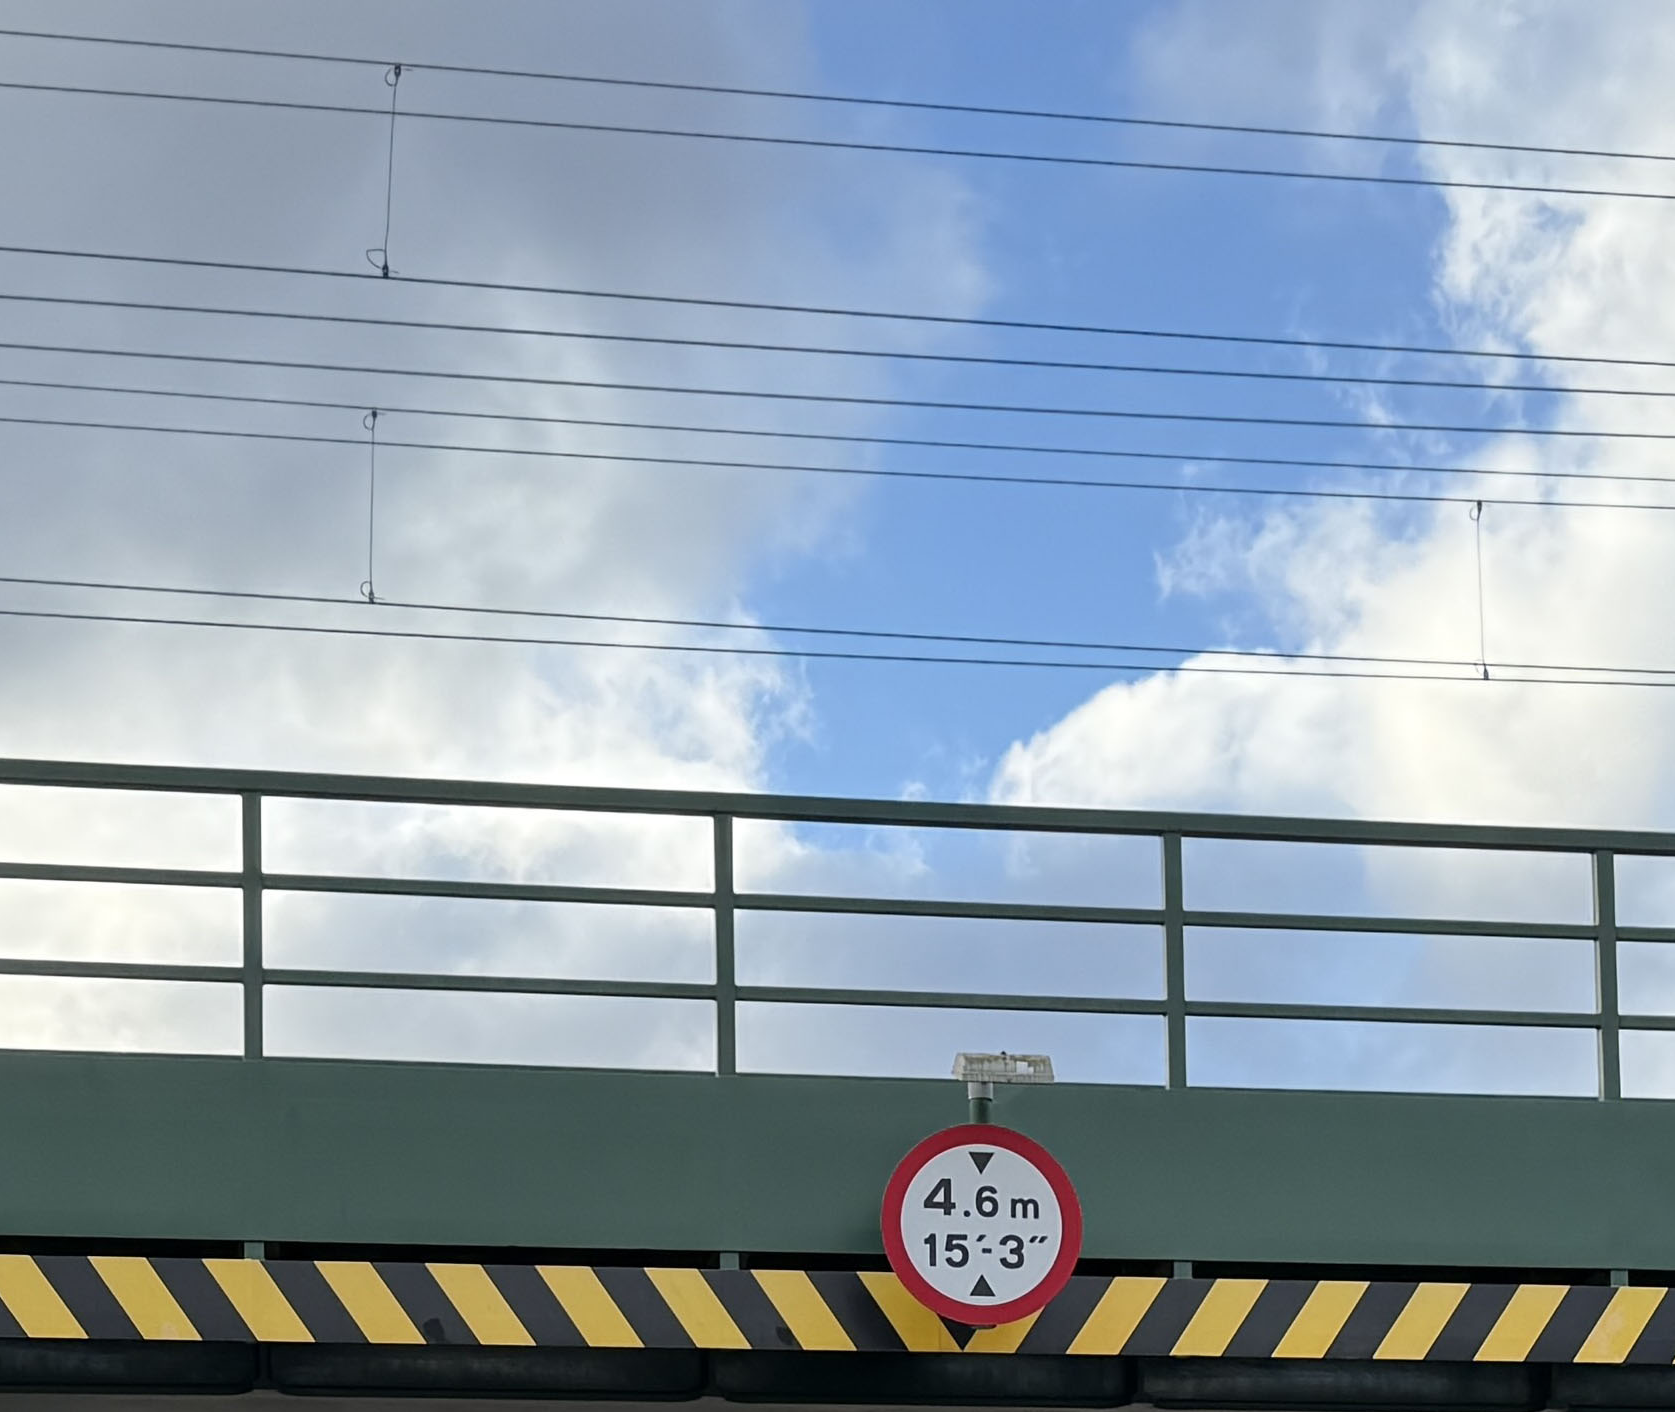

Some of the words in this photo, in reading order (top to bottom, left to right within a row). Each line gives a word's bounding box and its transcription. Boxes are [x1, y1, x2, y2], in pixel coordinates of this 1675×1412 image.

[923, 1178, 999, 1218] 4.6
[1010, 1198, 1039, 1219] m
[924, 1233, 1048, 1270] 15'-3"
